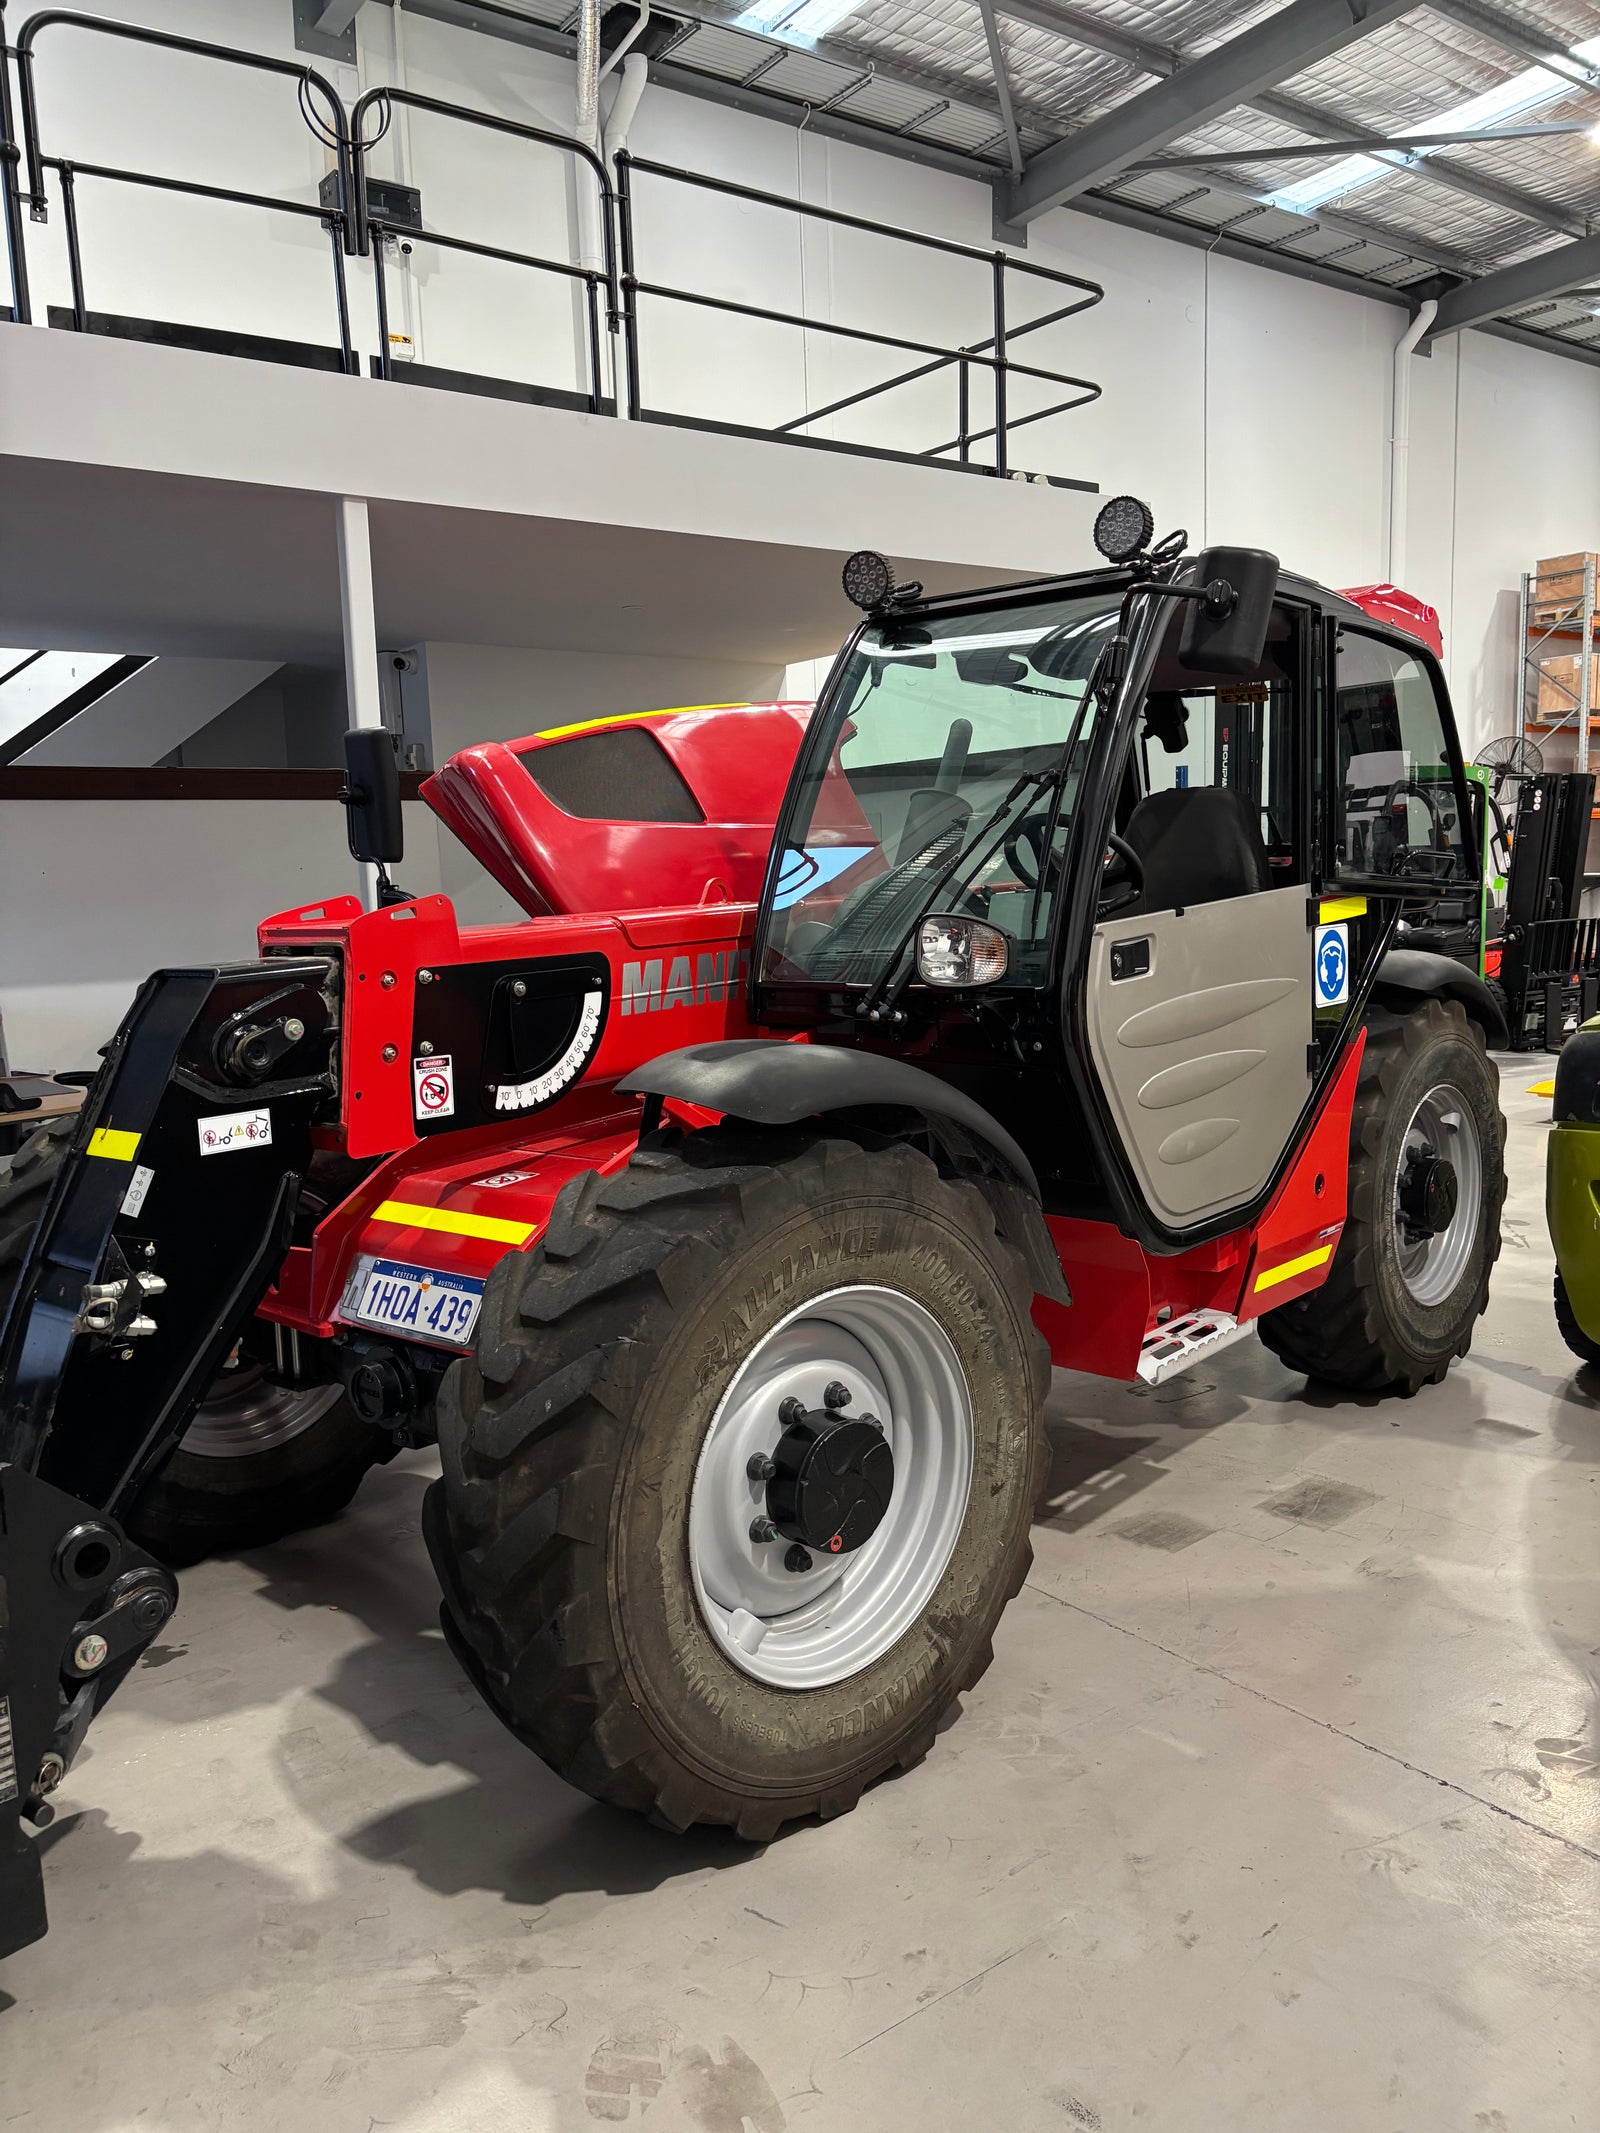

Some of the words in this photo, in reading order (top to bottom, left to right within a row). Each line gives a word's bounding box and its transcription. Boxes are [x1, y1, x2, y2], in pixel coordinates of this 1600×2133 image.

[1221, 686, 1263, 695] EMERGENCY
[1221, 692, 1265, 703] EXIT
[392, 1270, 418, 1281] WESTERN
[438, 1279, 464, 1290] AUSTRALIA
[722, 1226, 880, 1358] ALLIANCE
[733, 1714, 787, 1743] TUBELESS
